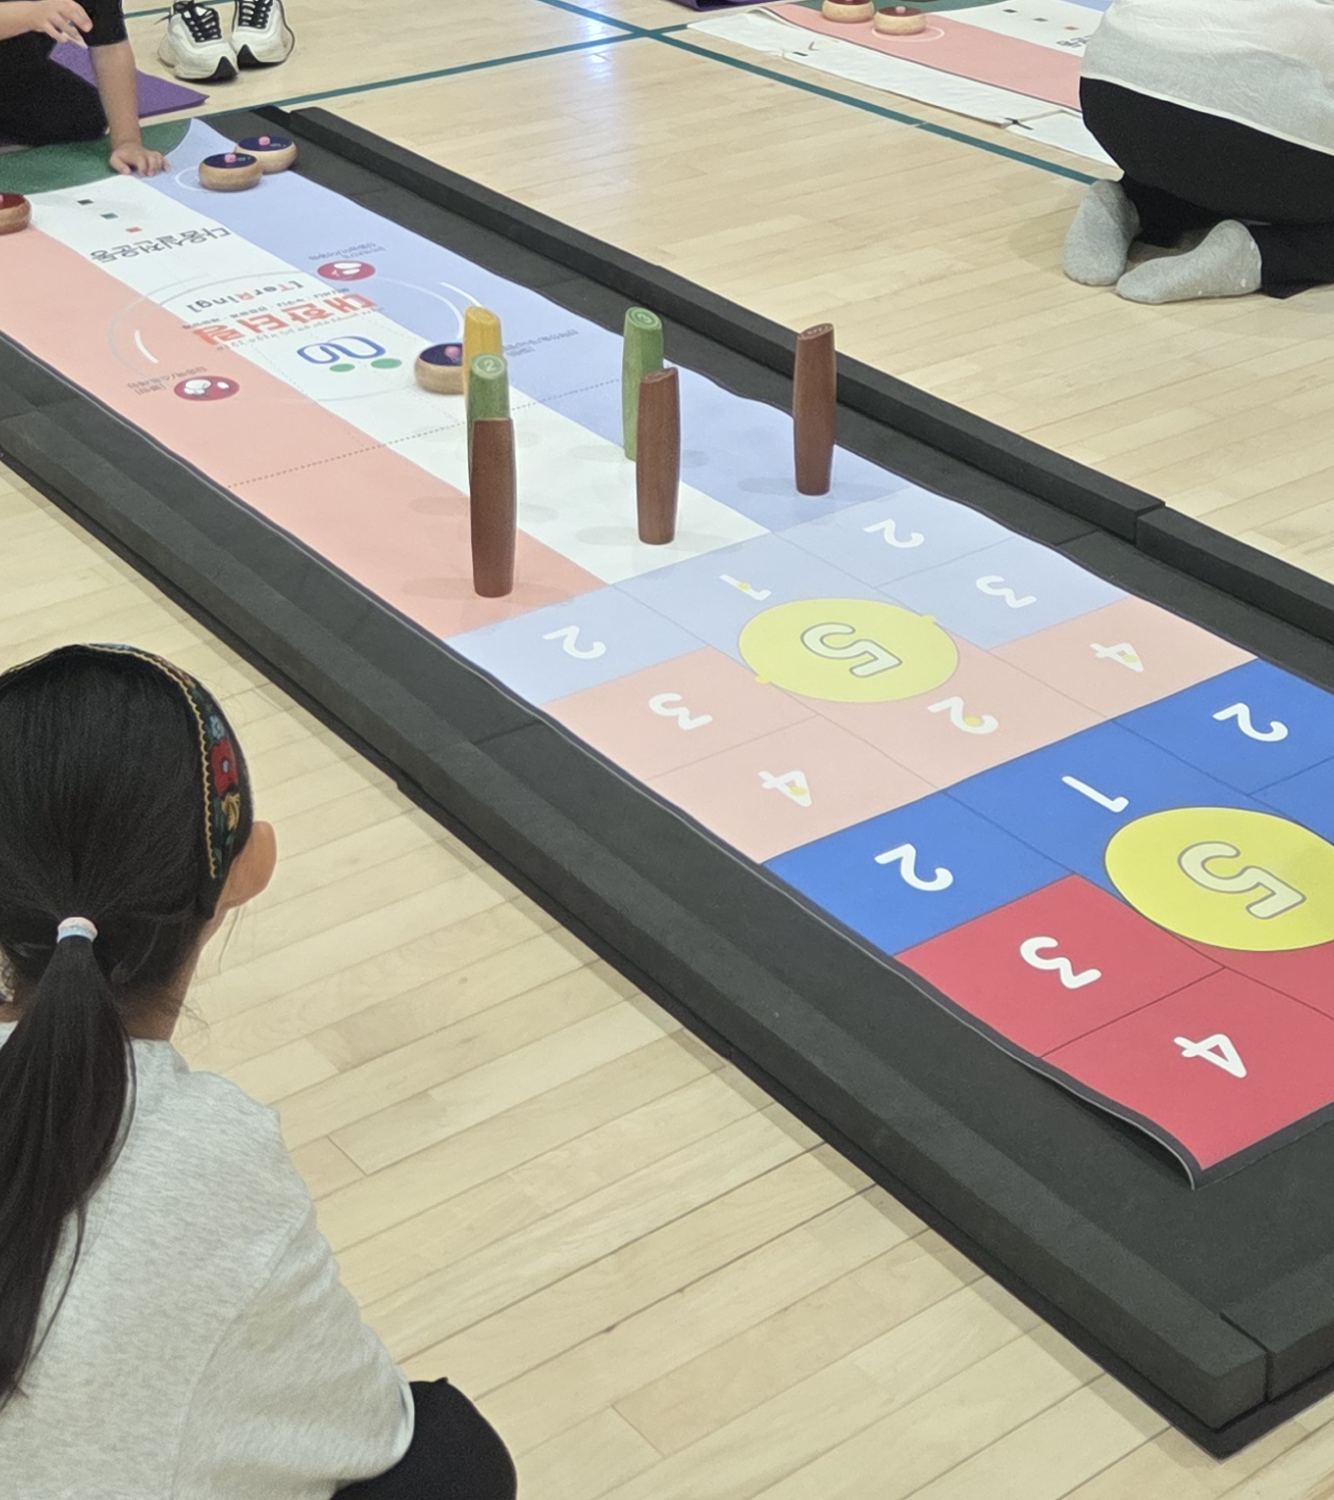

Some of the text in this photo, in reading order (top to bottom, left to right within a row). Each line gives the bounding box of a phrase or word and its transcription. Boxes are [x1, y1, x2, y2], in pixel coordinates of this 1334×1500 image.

[193, 293, 378, 346] 대한터링
[863, 518, 925, 549] 2
[718, 573, 773, 603] 1
[975, 574, 1038, 609] 3
[542, 625, 607, 660] 2
[800, 621, 903, 678] 5
[1089, 642, 1145, 673] 4
[648, 692, 713, 731] 3
[926, 695, 999, 735] 2
[1212, 702, 1289, 742] 2
[757, 769, 812, 808] 4
[1061, 775, 1129, 813] 1
[874, 843, 954, 892] 2
[1177, 840, 1307, 920] 5
[1019, 936, 1102, 989] 3
[1173, 1033, 1247, 1079] 4
